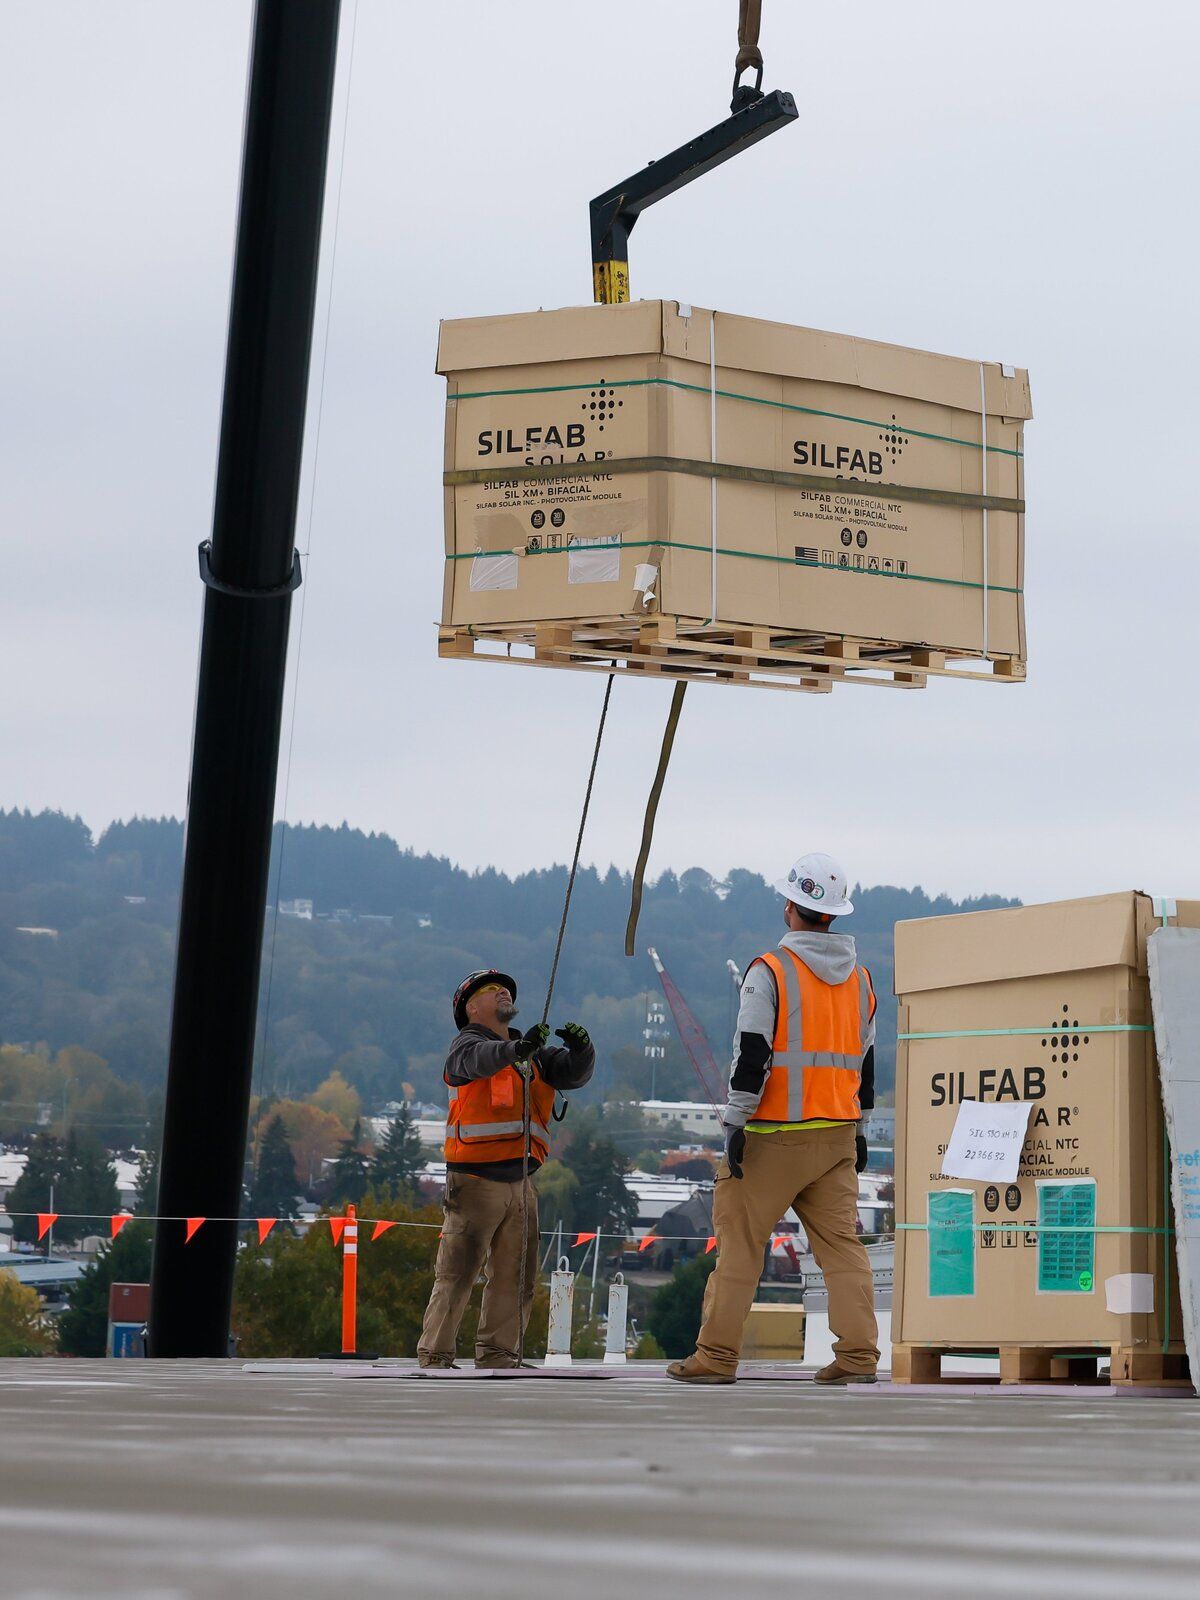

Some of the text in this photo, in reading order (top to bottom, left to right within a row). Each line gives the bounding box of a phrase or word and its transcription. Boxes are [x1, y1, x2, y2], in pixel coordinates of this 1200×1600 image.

[478, 424, 586, 455] SILFAB
[793, 440, 883, 475] SILFAB
[484, 474, 613, 490] SILFAB COMMERCIAL NTC
[504, 485, 592, 499] SIL XM+ BIFACIAL
[541, 495, 591, 504] PHOTOVOLTAIC
[801, 492, 902, 513] SILFAB COMMERCIAL NTC
[819, 504, 887, 521] SIL XM+ BIFACIAL
[794, 510, 813, 518] SILFAB
[815, 513, 834, 521] SOLAR
[849, 518, 887, 529] PHOTOVOLTAIC
[888, 523, 908, 532] MODULE
[931, 1067, 1046, 1106] SILFAB
[969, 1128, 984, 1138] SIL
[1056, 1138, 1079, 1149] NTC
[964, 1150, 1006, 1160] 2236632
[1020, 1154, 1054, 1165] ACIAL
[930, 1173, 950, 1181] SILFAB
[1017, 1167, 1090, 1177] VOLTAIC MODULE
